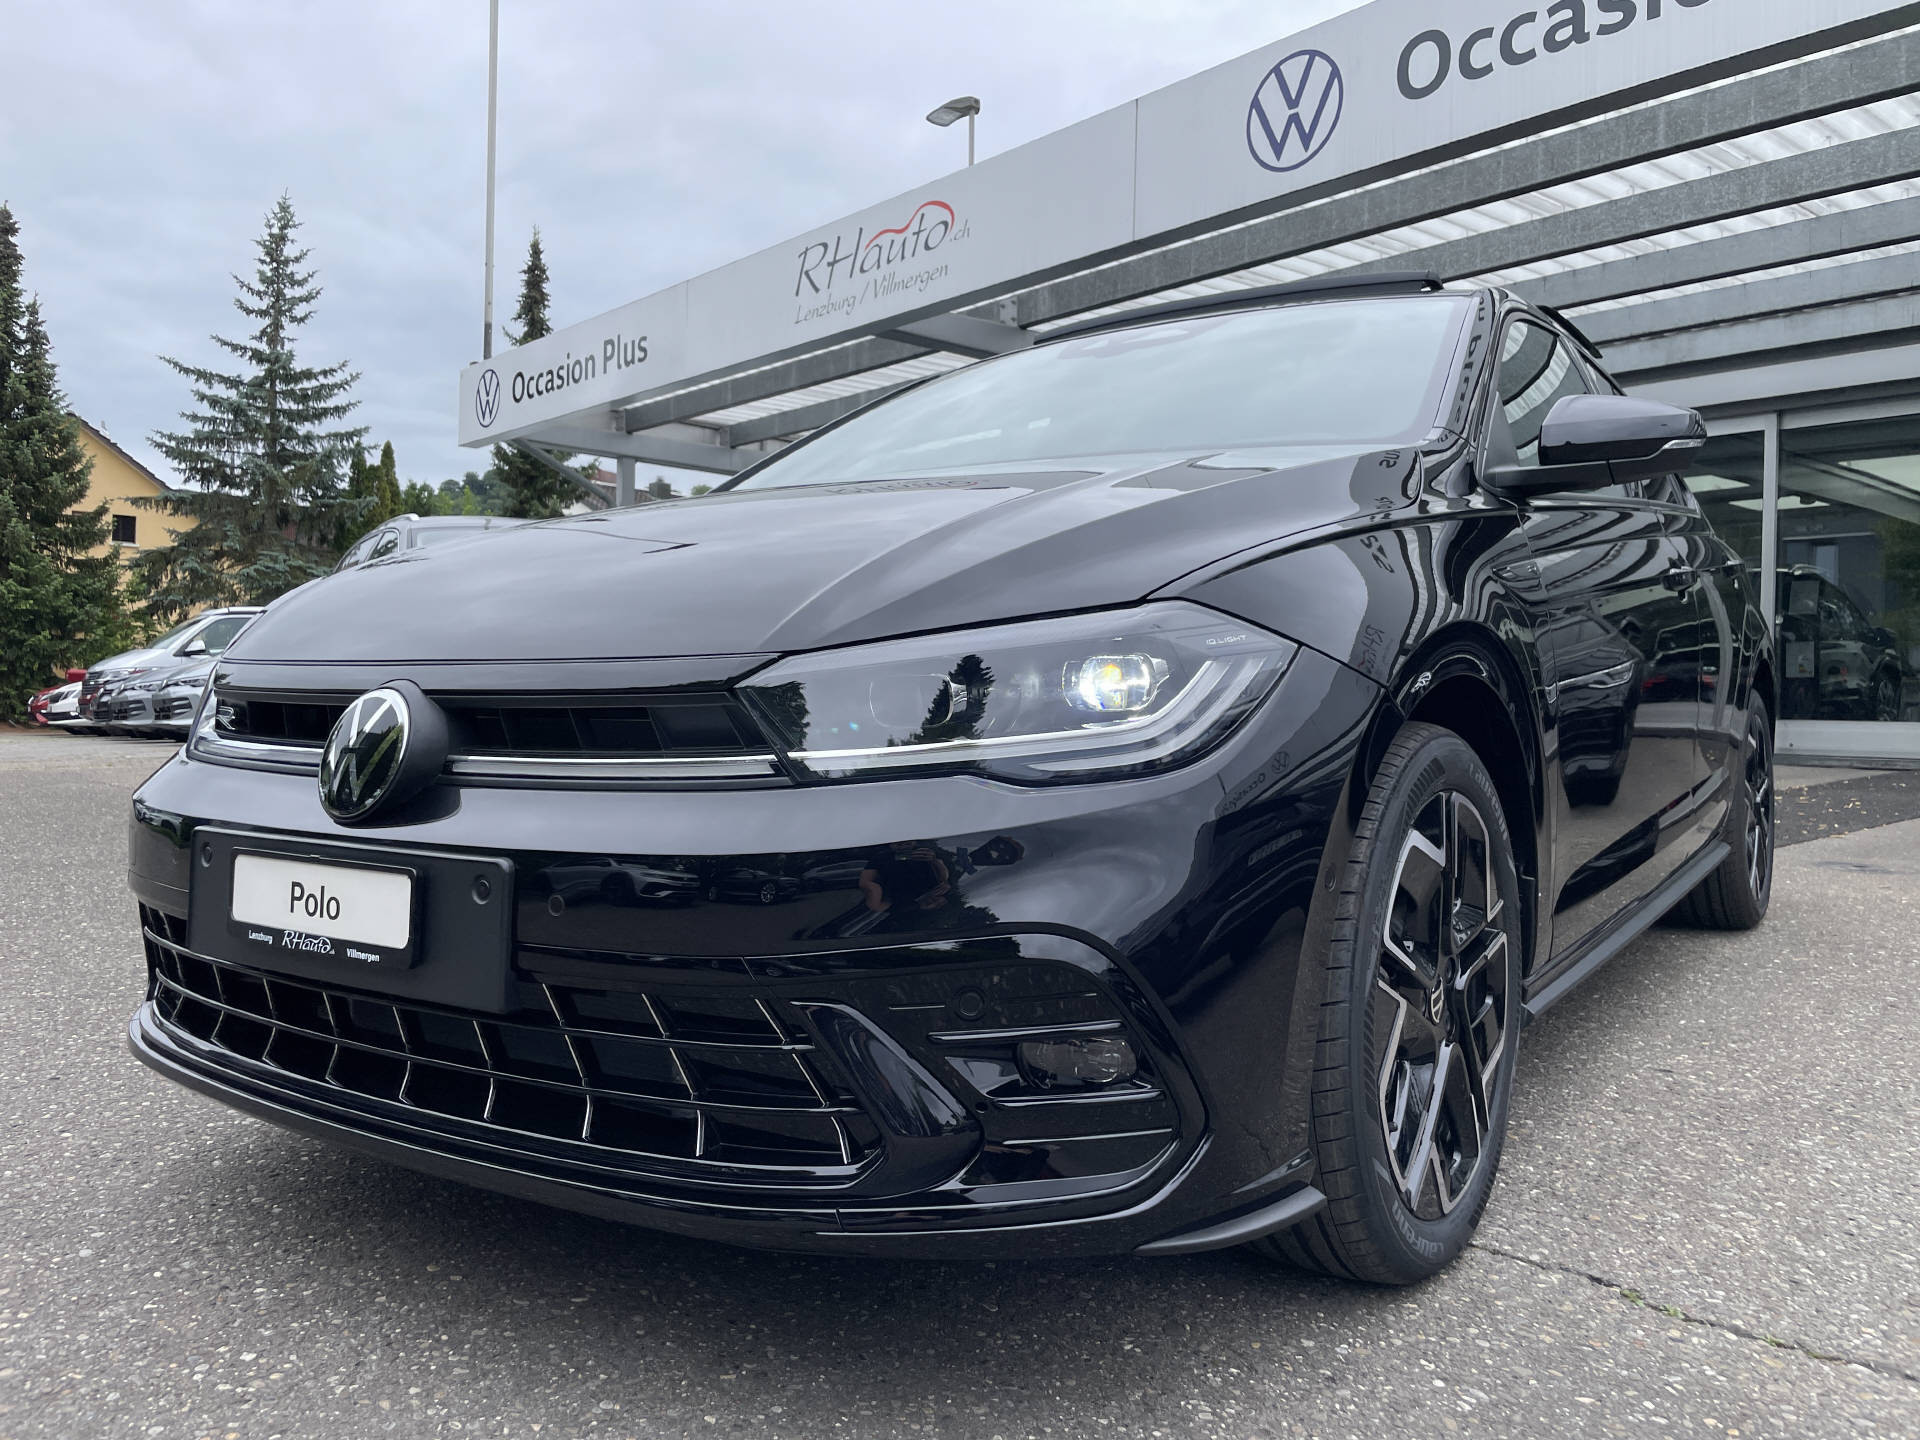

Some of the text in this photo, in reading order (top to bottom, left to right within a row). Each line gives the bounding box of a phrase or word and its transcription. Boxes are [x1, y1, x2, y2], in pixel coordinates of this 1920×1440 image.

[1396, 0, 1711, 100] Occas
[794, 293, 857, 324] Lenzburg
[873, 264, 949, 299] Villmergen
[512, 334, 648, 403] Occasion Plus
[289, 881, 341, 921] Polo
